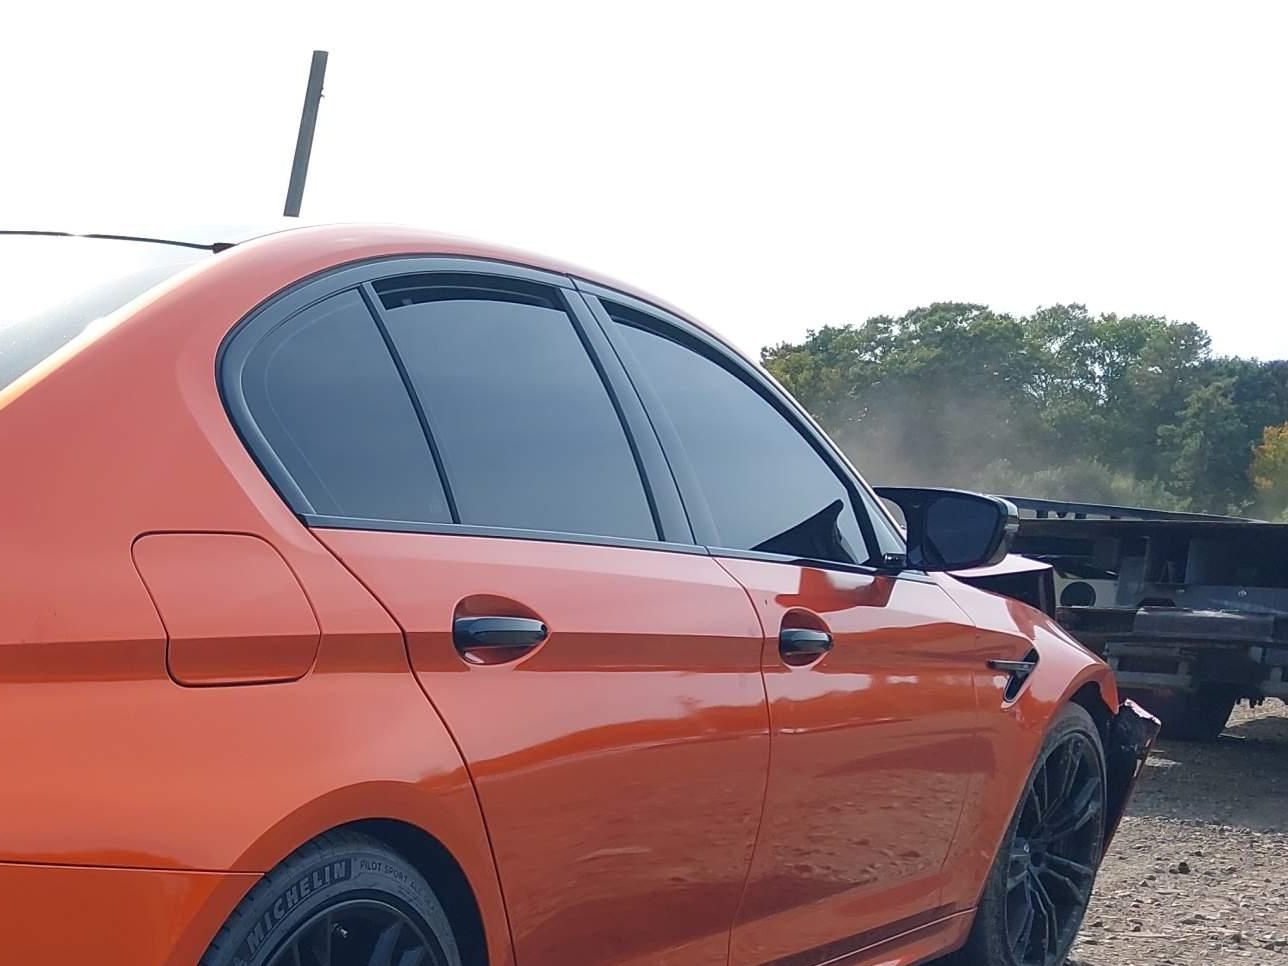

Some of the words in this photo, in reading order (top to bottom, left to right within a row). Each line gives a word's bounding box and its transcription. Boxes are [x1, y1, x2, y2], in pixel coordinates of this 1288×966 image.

[360, 859, 382, 873] PILOT
[383, 864, 408, 883] SPORT
[244, 859, 349, 956] MICHELIN
